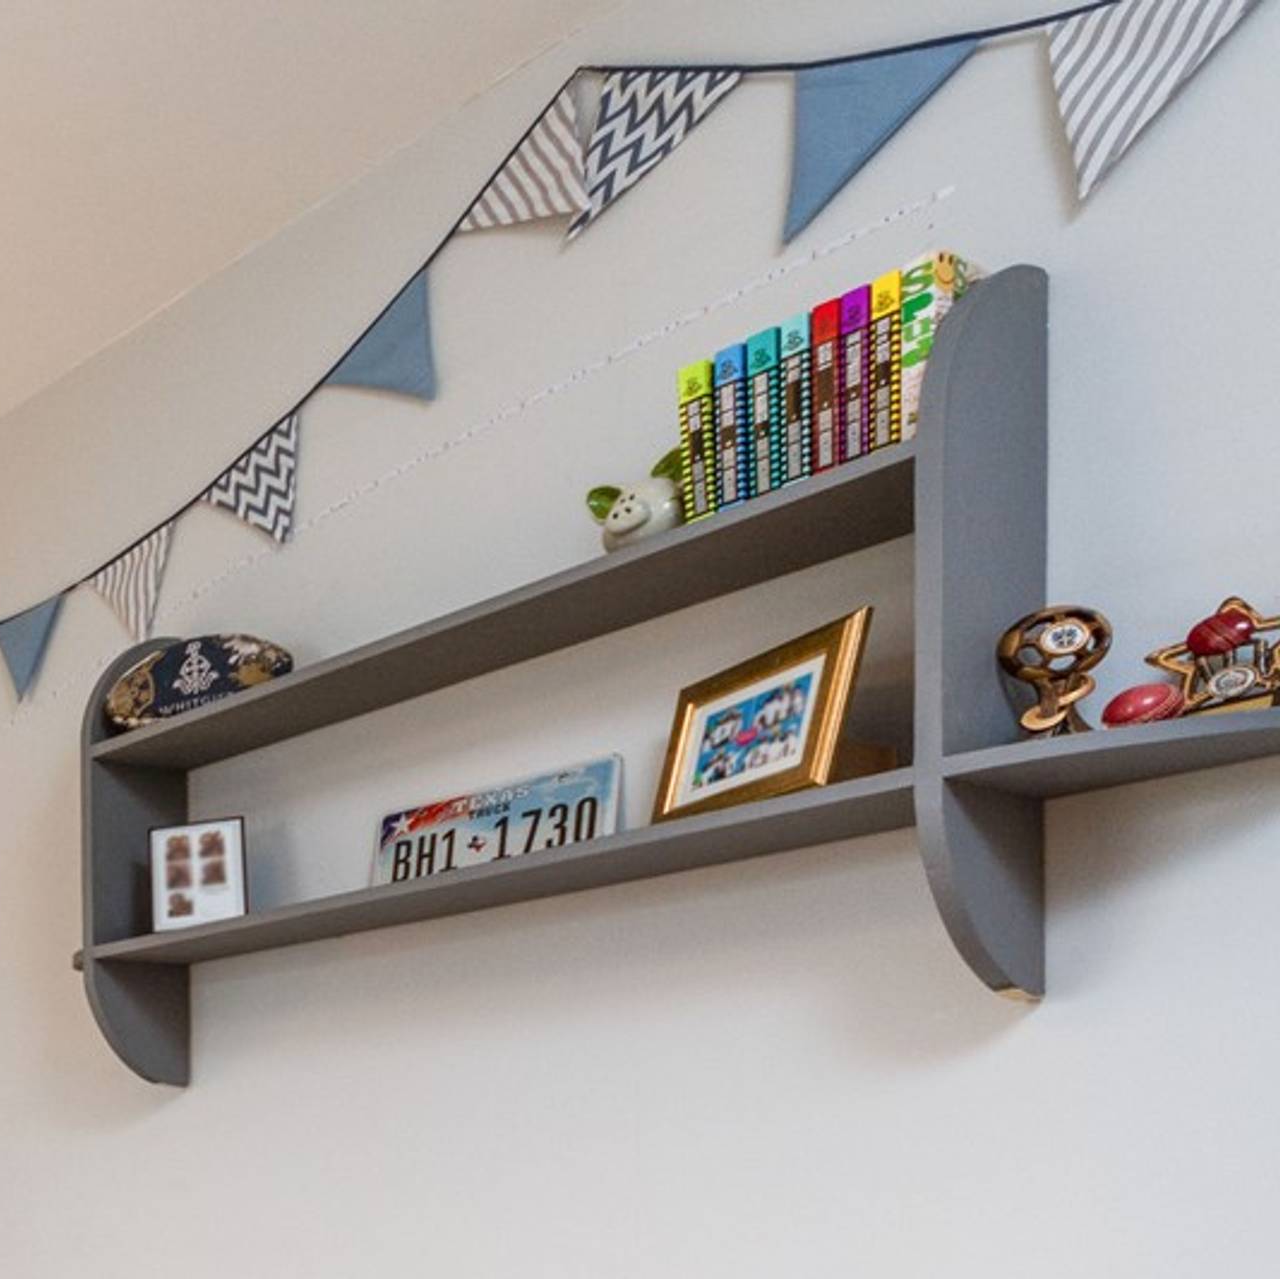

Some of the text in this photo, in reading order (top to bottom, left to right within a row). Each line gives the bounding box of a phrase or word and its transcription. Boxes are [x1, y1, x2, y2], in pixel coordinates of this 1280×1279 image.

[453, 785, 531, 814] TEXAS
[392, 796, 599, 883] BH1 1730
